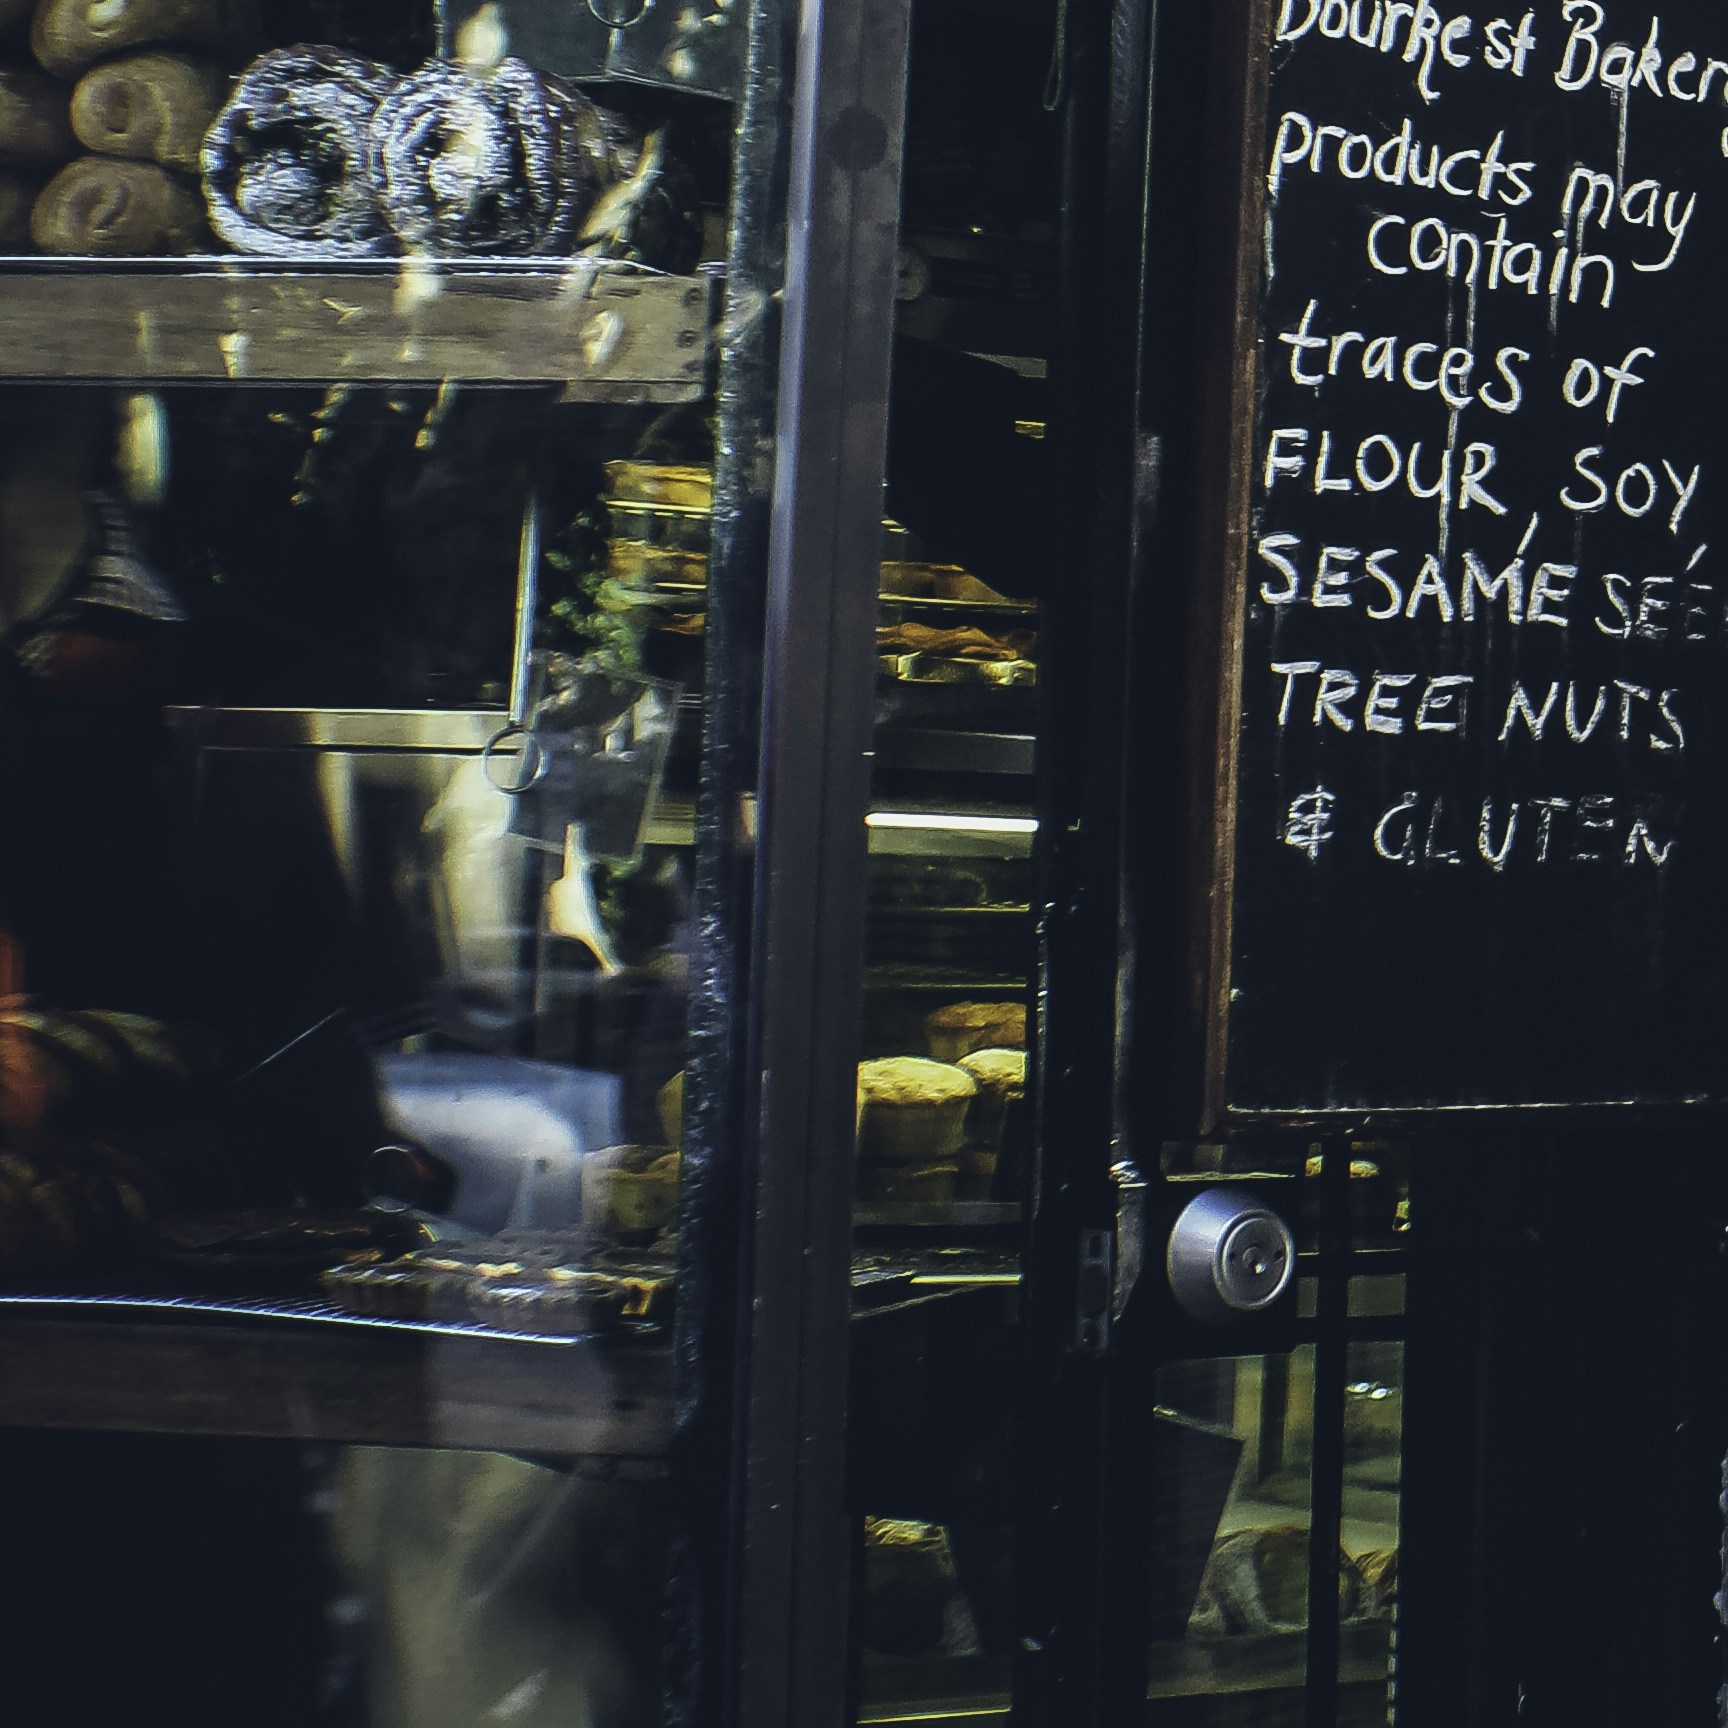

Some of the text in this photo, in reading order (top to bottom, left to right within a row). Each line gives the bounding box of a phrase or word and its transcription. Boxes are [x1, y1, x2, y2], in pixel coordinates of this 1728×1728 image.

[1268, 111, 1697, 271] products may
[1367, 213, 1615, 308] contain
[1279, 299, 1656, 424] traces of
[1270, 661, 1685, 750] TREE NUTS
